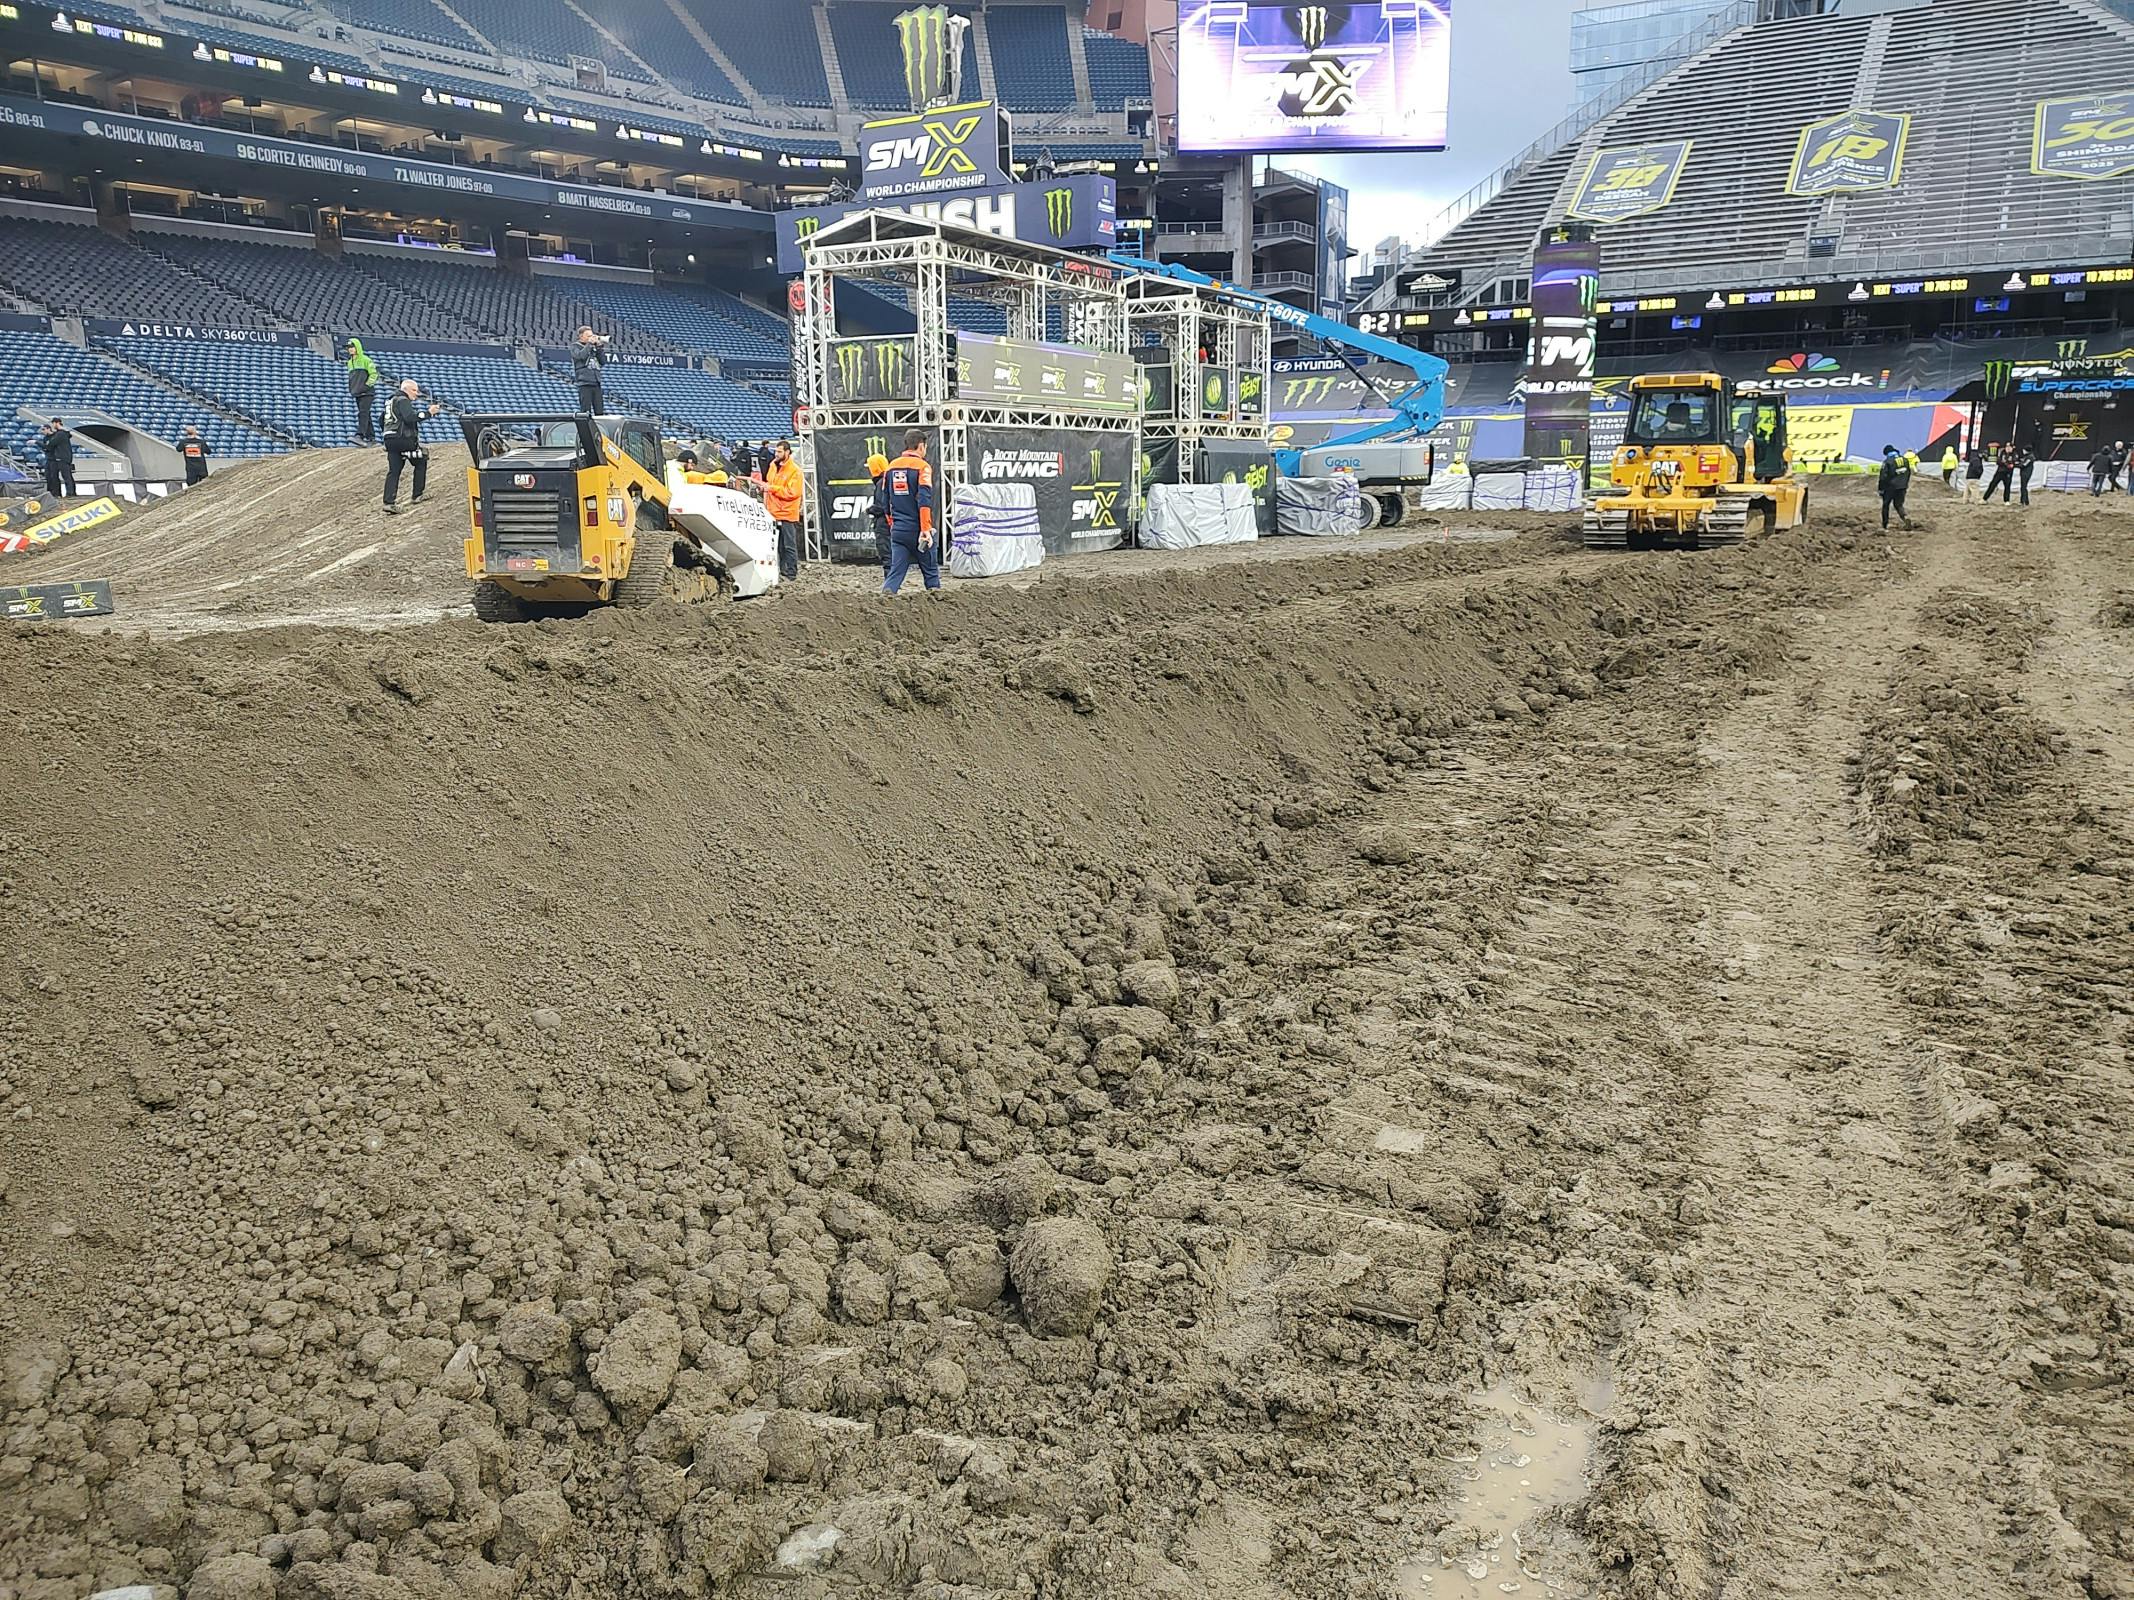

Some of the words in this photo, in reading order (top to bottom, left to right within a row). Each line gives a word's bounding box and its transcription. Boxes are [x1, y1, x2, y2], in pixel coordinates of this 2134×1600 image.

[74, 19, 93, 34] TEXT
[16, 113, 45, 128] 80-91
[104, 123, 145, 144] CHUCK
[148, 130, 180, 149] KNOX
[180, 138, 205, 152] 83-91
[864, 116, 981, 177] SMX
[1807, 134, 1889, 168] 18
[237, 143, 256, 160] 96
[257, 147, 296, 166] CORTEZ
[298, 153, 343, 173] KENNEDY
[394, 167, 409, 182] 71
[409, 169, 445, 187] WALTER
[446, 174, 473, 191] JONES
[1591, 164, 1669, 192] 38
[866, 184, 902, 198] WORLD
[904, 174, 985, 192] CHAMPIONSHIP
[558, 191, 566, 203] 8
[566, 192, 588, 207] MATT
[588, 195, 636, 213] HASSELBECK
[2031, 273, 2050, 286] TEXT
[2050, 272, 2086, 285] "SUPER"
[2086, 271, 2098, 283] TO
[1873, 283, 1891, 296] TEXT
[1892, 282, 1924, 294] "SUPER"
[140, 324, 195, 339] DELTA
[1294, 360, 1345, 371] HYUNDAI
[2052, 359, 2125, 370] MONSTER
[1733, 372, 1874, 390] eacock
[2019, 379, 2134, 393] SUPERCROS
[2054, 390, 2112, 401] Championship
[994, 448, 1018, 461] ROCKY
[1018, 448, 1059, 461] MOUNTAIN
[1325, 456, 1361, 467] Genie
[1651, 461, 1679, 476] CAT
[513, 473, 530, 485] CAT
[607, 498, 625, 521] CAT
[831, 495, 875, 519] SM
[1071, 492, 1118, 527] SMX
[36, 503, 112, 539] SUZUKI
[833, 531, 861, 540] WORLD
[8, 600, 42, 614] SMX
[63, 595, 97, 609] SMX
